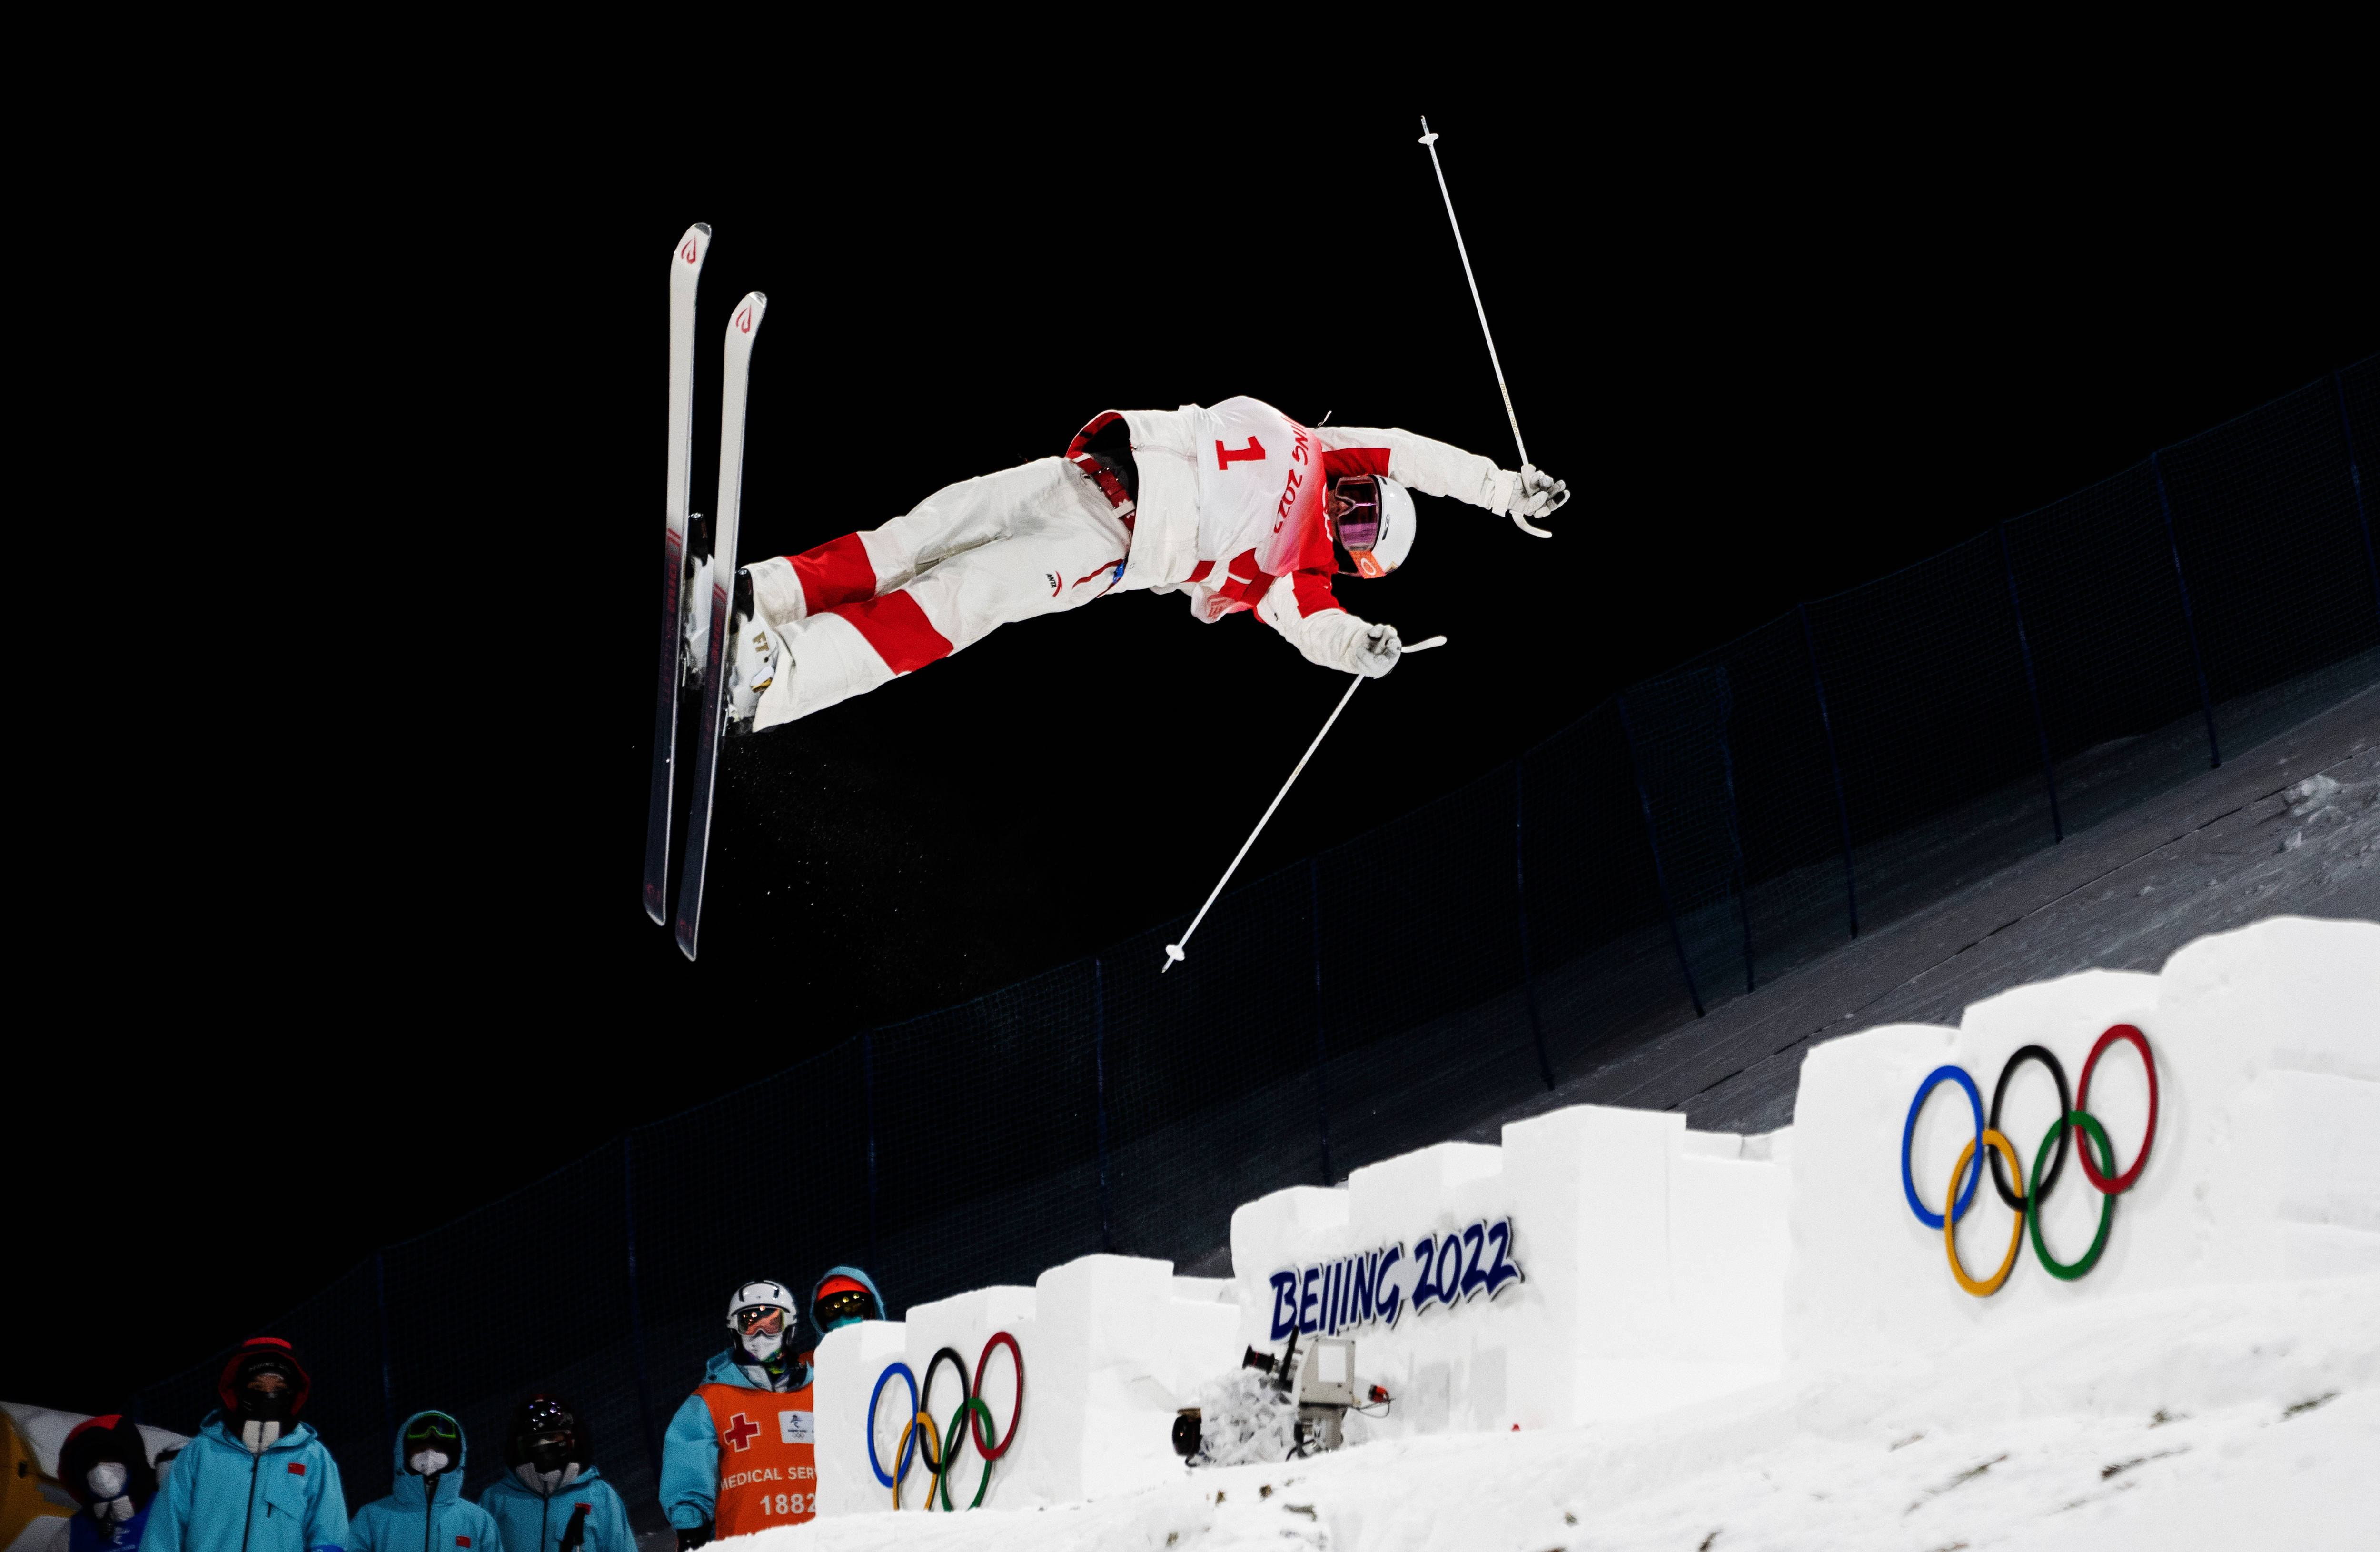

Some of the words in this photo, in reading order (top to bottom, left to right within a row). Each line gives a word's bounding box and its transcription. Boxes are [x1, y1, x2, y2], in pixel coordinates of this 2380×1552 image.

[1510, 417, 1520, 438] RIDE
[1215, 435, 1266, 470] 1
[1045, 573, 1057, 588] ANTA
[1269, 1246, 1402, 1342] BEIJING
[1411, 1219, 1519, 1311] 2022
[720, 1467, 783, 1491] MEDICAL
[788, 1466, 816, 1480] SER
[759, 1492, 816, 1516] 1882
